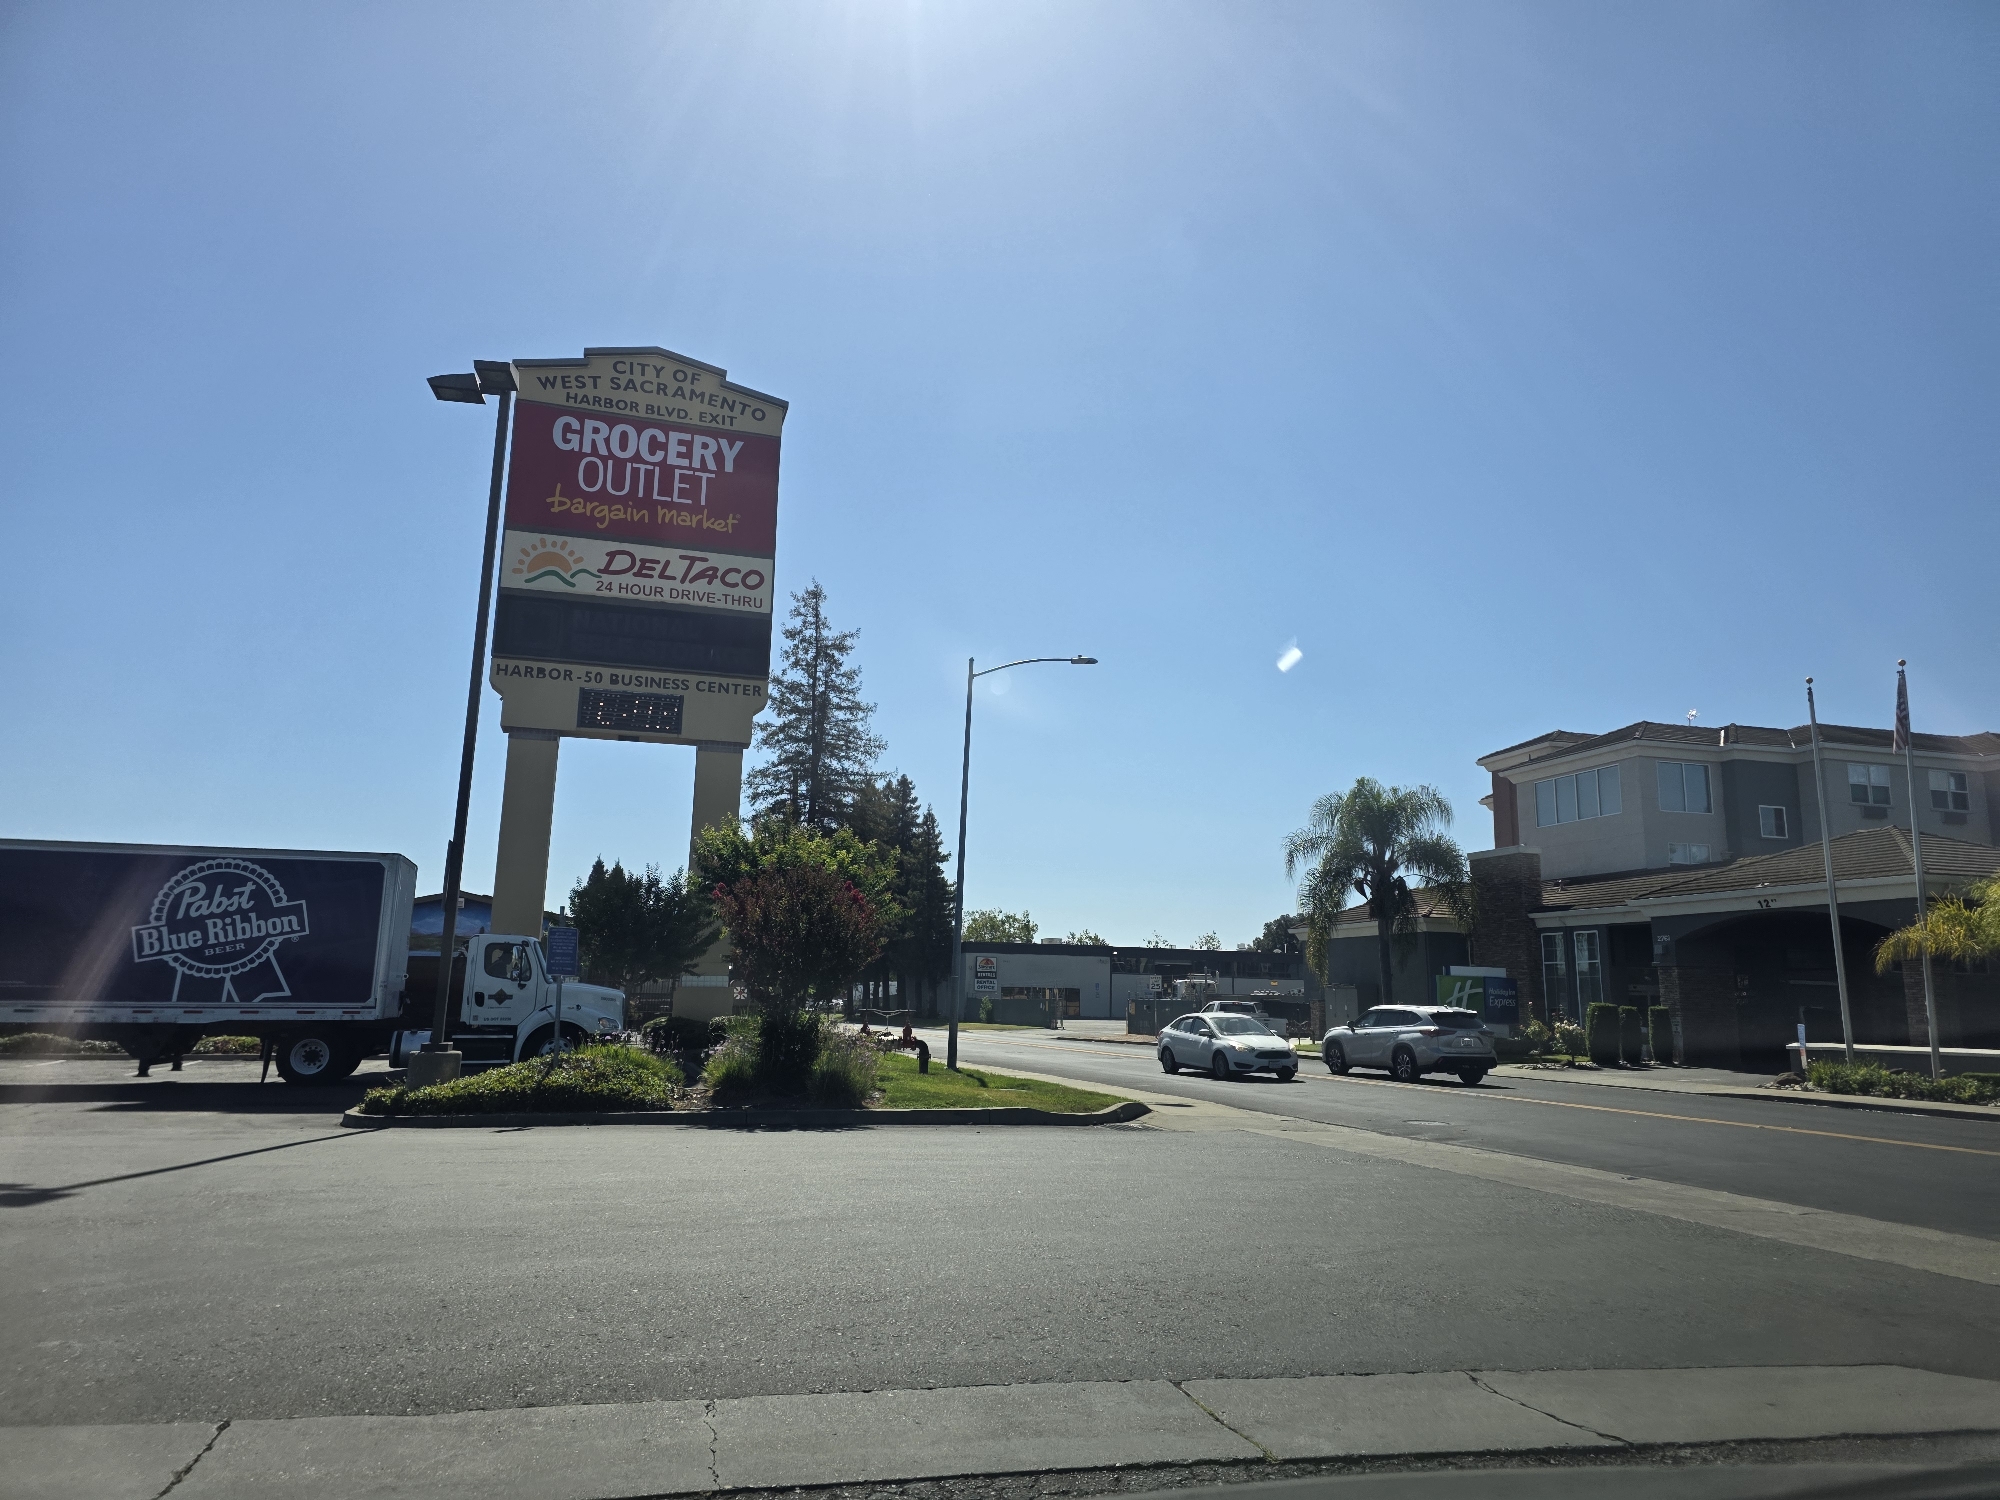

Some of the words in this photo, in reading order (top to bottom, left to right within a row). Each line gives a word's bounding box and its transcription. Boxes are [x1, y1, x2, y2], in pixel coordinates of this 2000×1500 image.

[612, 360, 666, 379] CITY
[672, 369, 702, 386] OF
[536, 375, 601, 390] WEST
[610, 377, 766, 422] SACRAMENTO
[566, 392, 639, 414] HARBOR
[645, 404, 692, 421] BLVD.
[700, 412, 737, 427] EXIT
[552, 416, 744, 472] GROCERY
[578, 456, 716, 506] OUTLET
[546, 483, 649, 529] bargain
[657, 505, 738, 533] market
[596, 581, 613, 593] 24
[618, 583, 664, 598] HOUR
[670, 588, 763, 609] DRIVE-THRU
[610, 673, 690, 691] BUSINESS
[696, 680, 762, 697] CENTER
[172, 881, 256, 919] Pabst
[140, 926, 202, 956] Blue
[205, 912, 300, 944] Ribbon
[204, 943, 245, 956] BEER
[1489, 988, 1508, 996] Holiday
[1489, 997, 1516, 1008] Express
